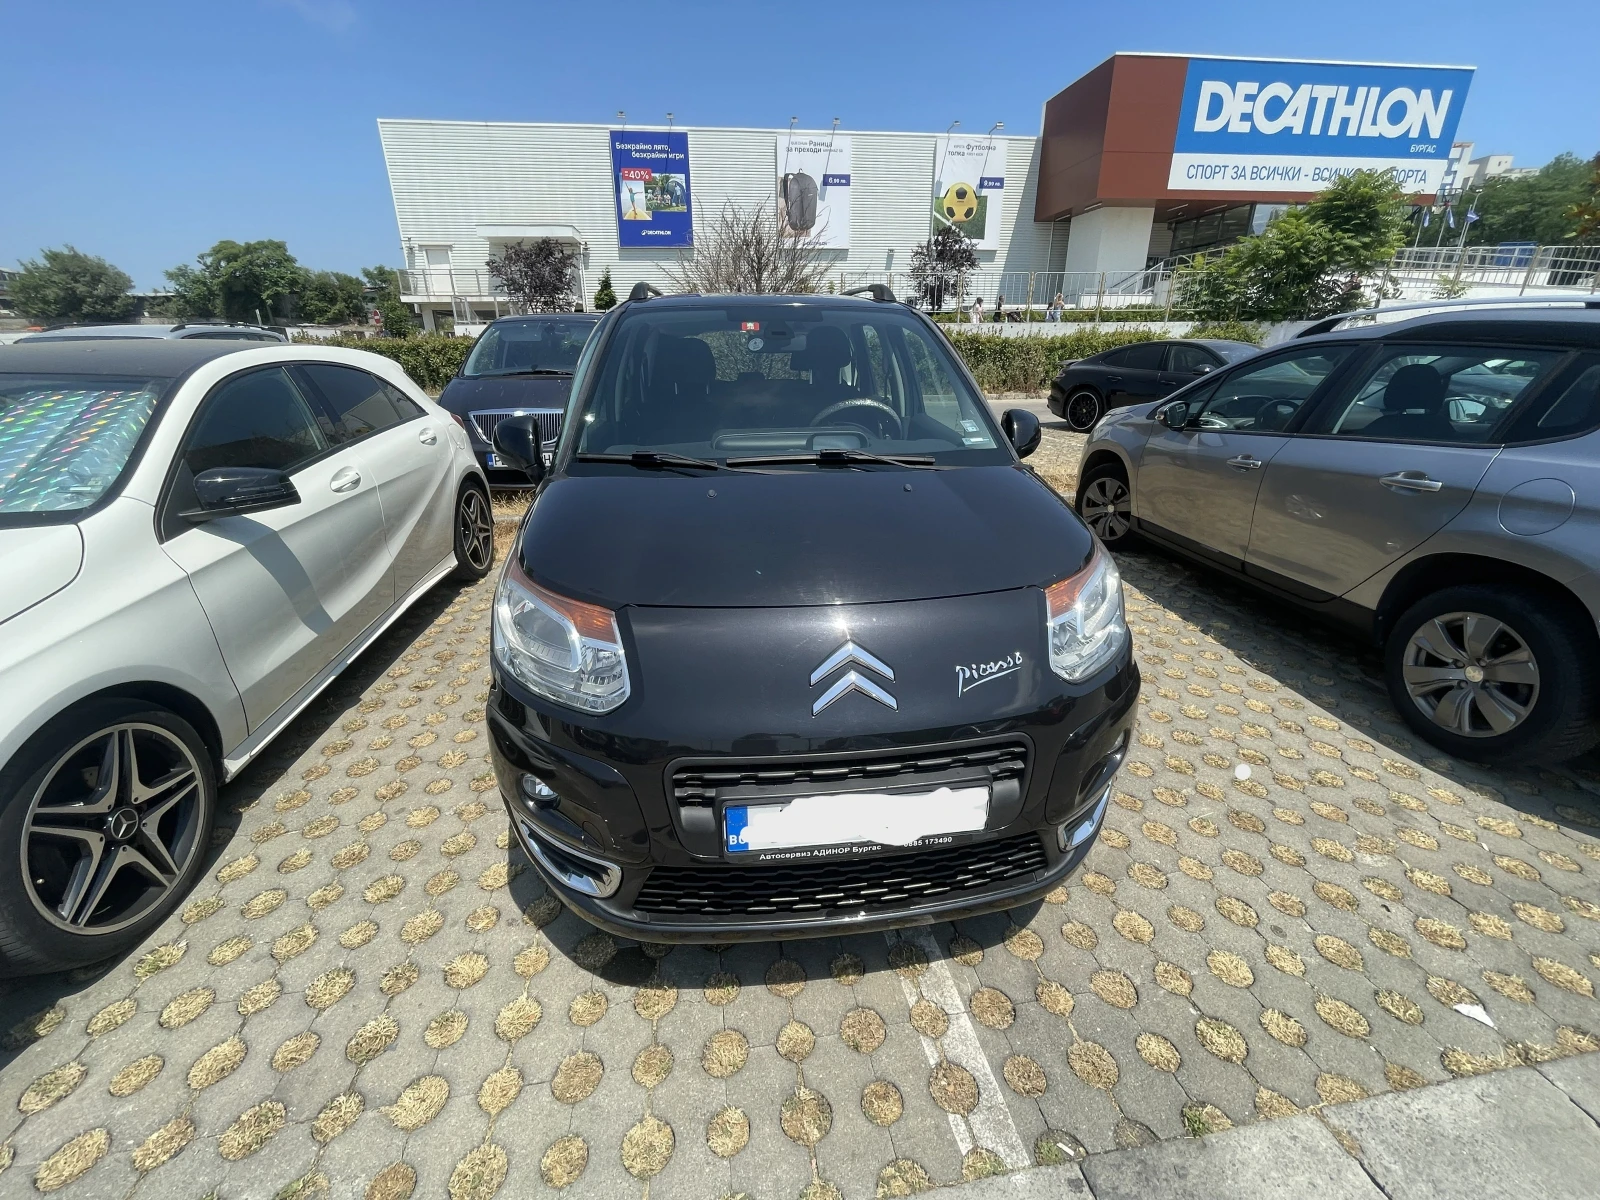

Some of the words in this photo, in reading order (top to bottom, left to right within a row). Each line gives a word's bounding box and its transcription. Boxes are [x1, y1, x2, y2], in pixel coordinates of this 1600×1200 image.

[1193, 80, 1453, 139] DECATHLON
[615, 142, 652, 150] Безкрайно
[653, 144, 671, 152] лято,
[808, 140, 833, 148] Раница
[1409, 144, 1437, 153] БУРГАС
[631, 150, 668, 159] безкрайни
[668, 152, 685, 160] игри
[1186, 164, 1229, 180] СПОРТ
[1230, 165, 1247, 180] ЗА
[1250, 166, 1301, 181] ВСИЧКИ
[759, 851, 811, 861] Автосервиз
[812, 847, 851, 857] АДИНОР
[852, 844, 882, 854] Бургас
[925, 837, 953, 845] 173490
